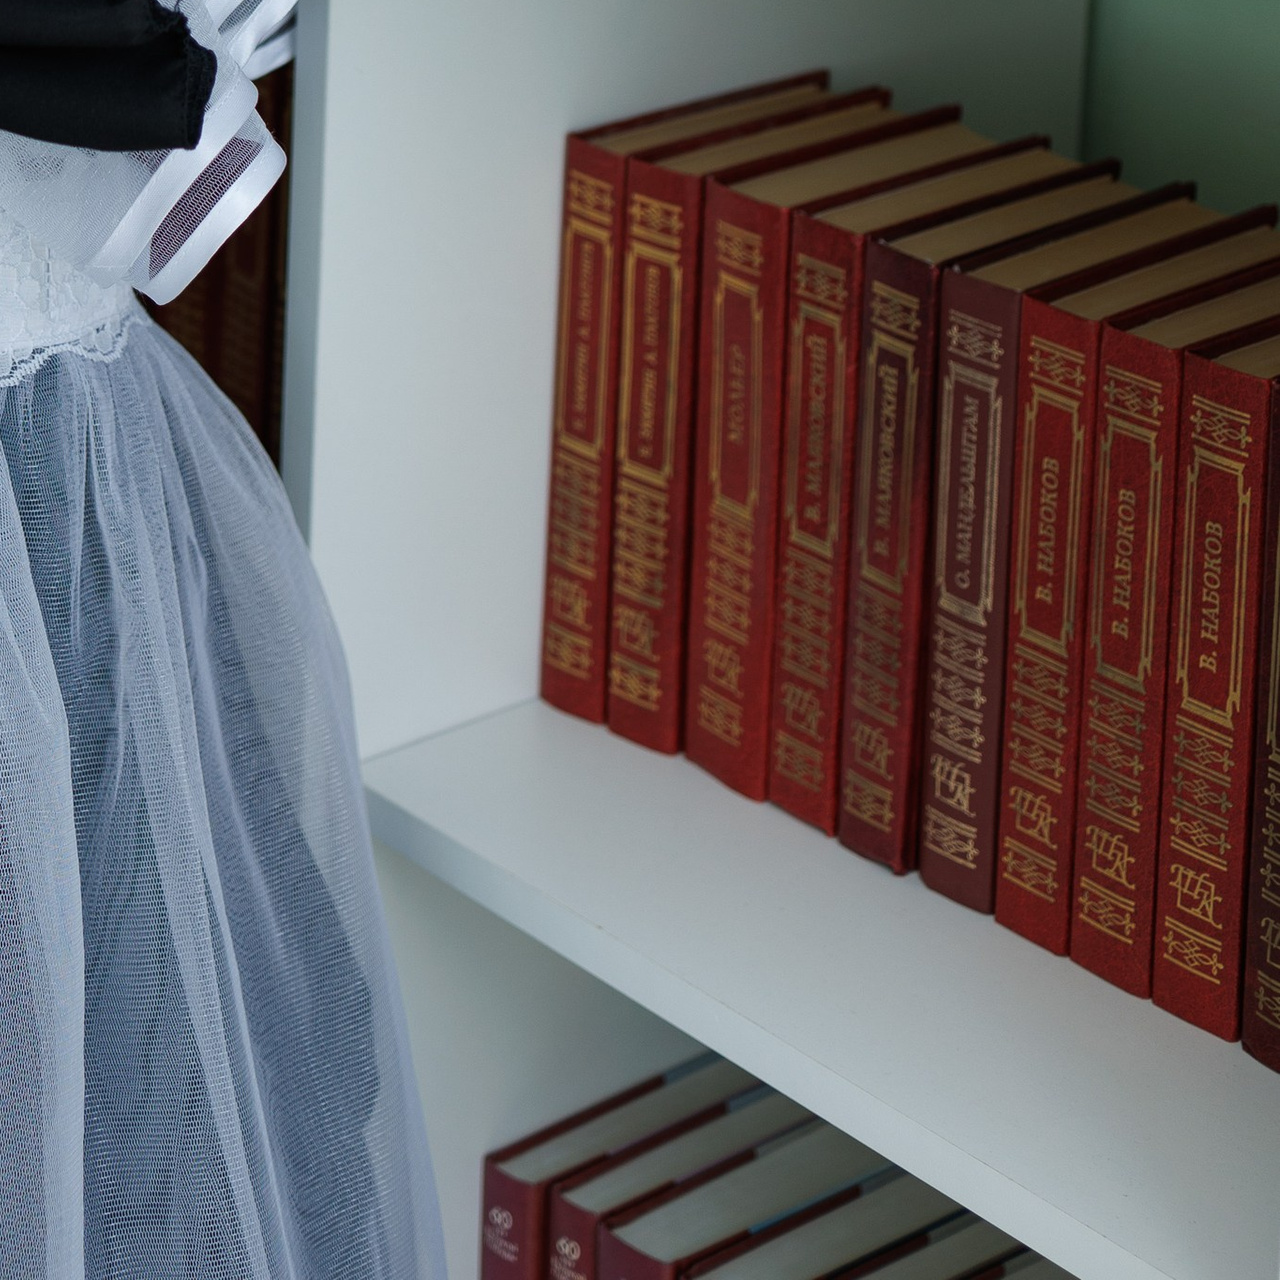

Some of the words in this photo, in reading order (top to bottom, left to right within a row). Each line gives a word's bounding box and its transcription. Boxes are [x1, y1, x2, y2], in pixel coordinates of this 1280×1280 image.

[875, 363, 899, 530] МАЯКОВСКИЙ
[956, 394, 980, 565] МАНДЕЛЬШТАМ
[1037, 456, 1060, 577] НАБОКОВ
[1113, 489, 1136, 610] НАБОКОВ
[954, 569, 970, 589] О.
[1035, 582, 1054, 605] В.
[1111, 617, 1129, 640] В.
[1201, 520, 1223, 645] НАБОКОВ
[1199, 651, 1218, 674] В.
